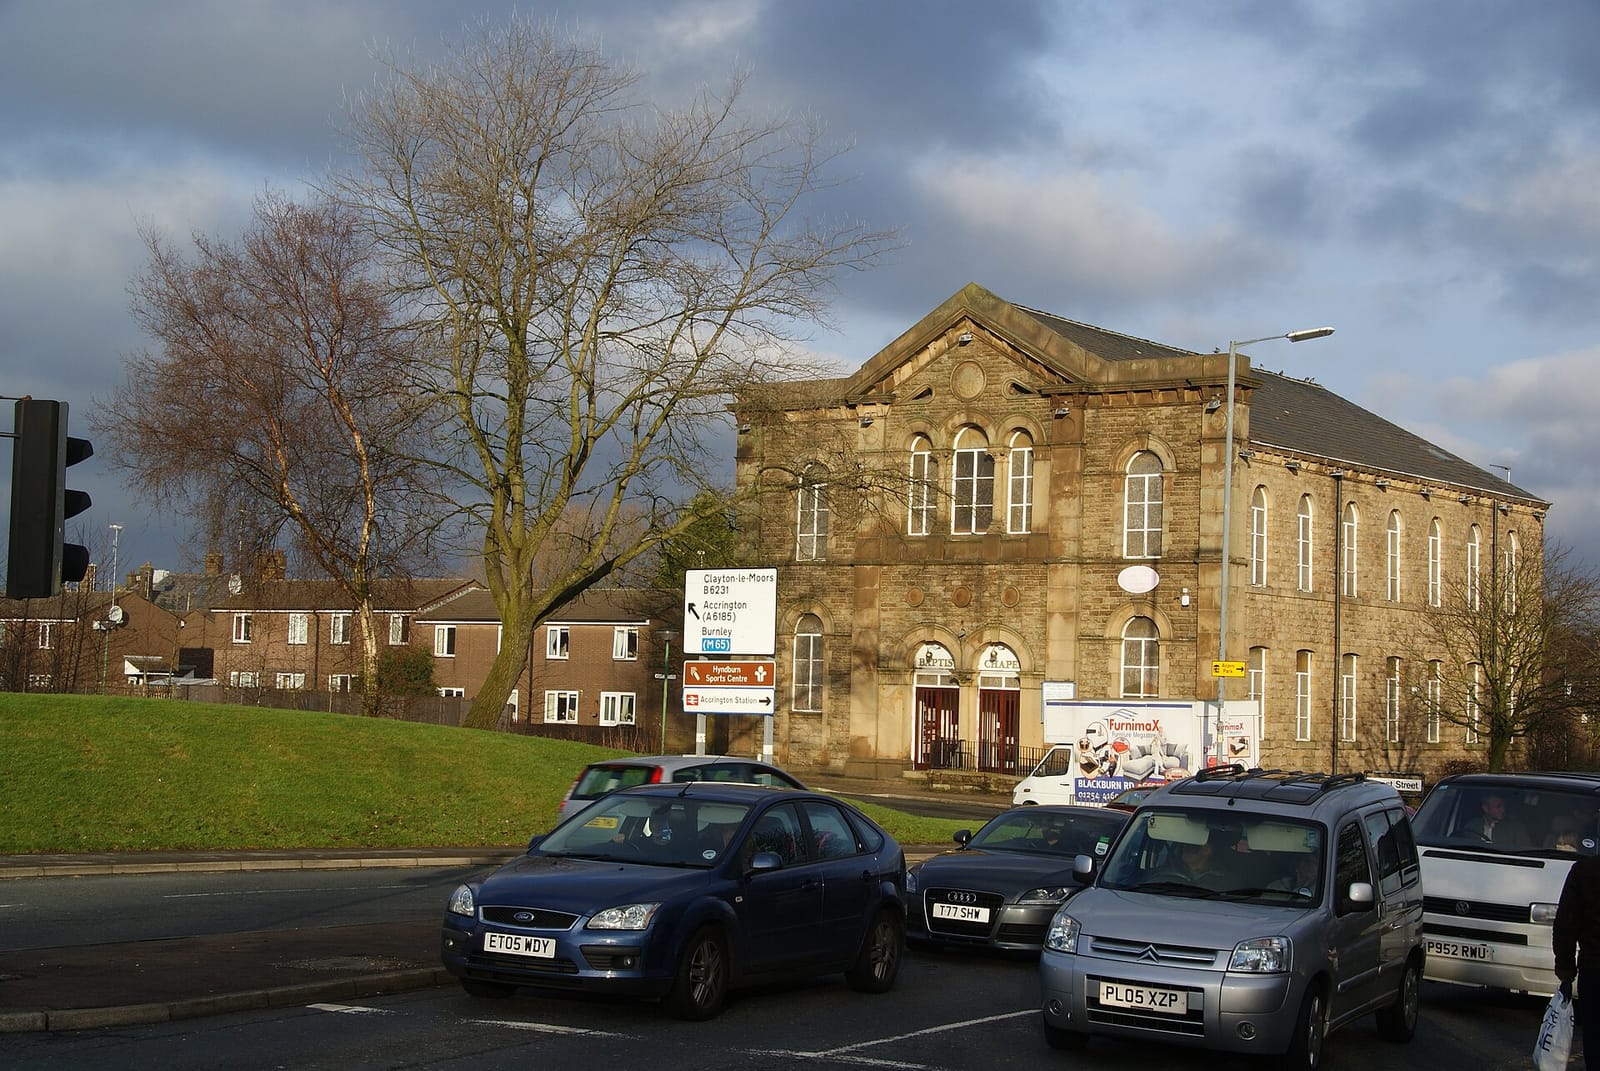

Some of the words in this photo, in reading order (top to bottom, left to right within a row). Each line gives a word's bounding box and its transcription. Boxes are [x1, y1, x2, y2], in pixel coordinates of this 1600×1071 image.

[703, 573, 774, 583] Clayton-le-Moors
[703, 601, 747, 611] Accrington
[702, 627, 732, 637] Burnley
[919, 658, 953, 667] BAPTIS
[984, 660, 1019, 669] CHAPE
[712, 665, 741, 675] Hyndburn
[705, 674, 726, 684] Sports
[727, 674, 748, 682] Centre
[700, 696, 734, 705] Accrington
[735, 696, 758, 704] Station
[1109, 718, 1160, 732] FurnimaX
[1078, 779, 1122, 790] BLACKBURN
[1395, 780, 1419, 790] Street
[1078, 791, 1100, 800] 01254
[940, 905, 958, 917] T77
[960, 907, 980, 920] SHW
[489, 934, 521, 951] ET05
[524, 937, 549, 953] WDY
[1427, 941, 1458, 956] P952
[1461, 945, 1486, 959] RWU
[1105, 986, 1144, 1004] PL05
[1148, 991, 1178, 1007] XZP
